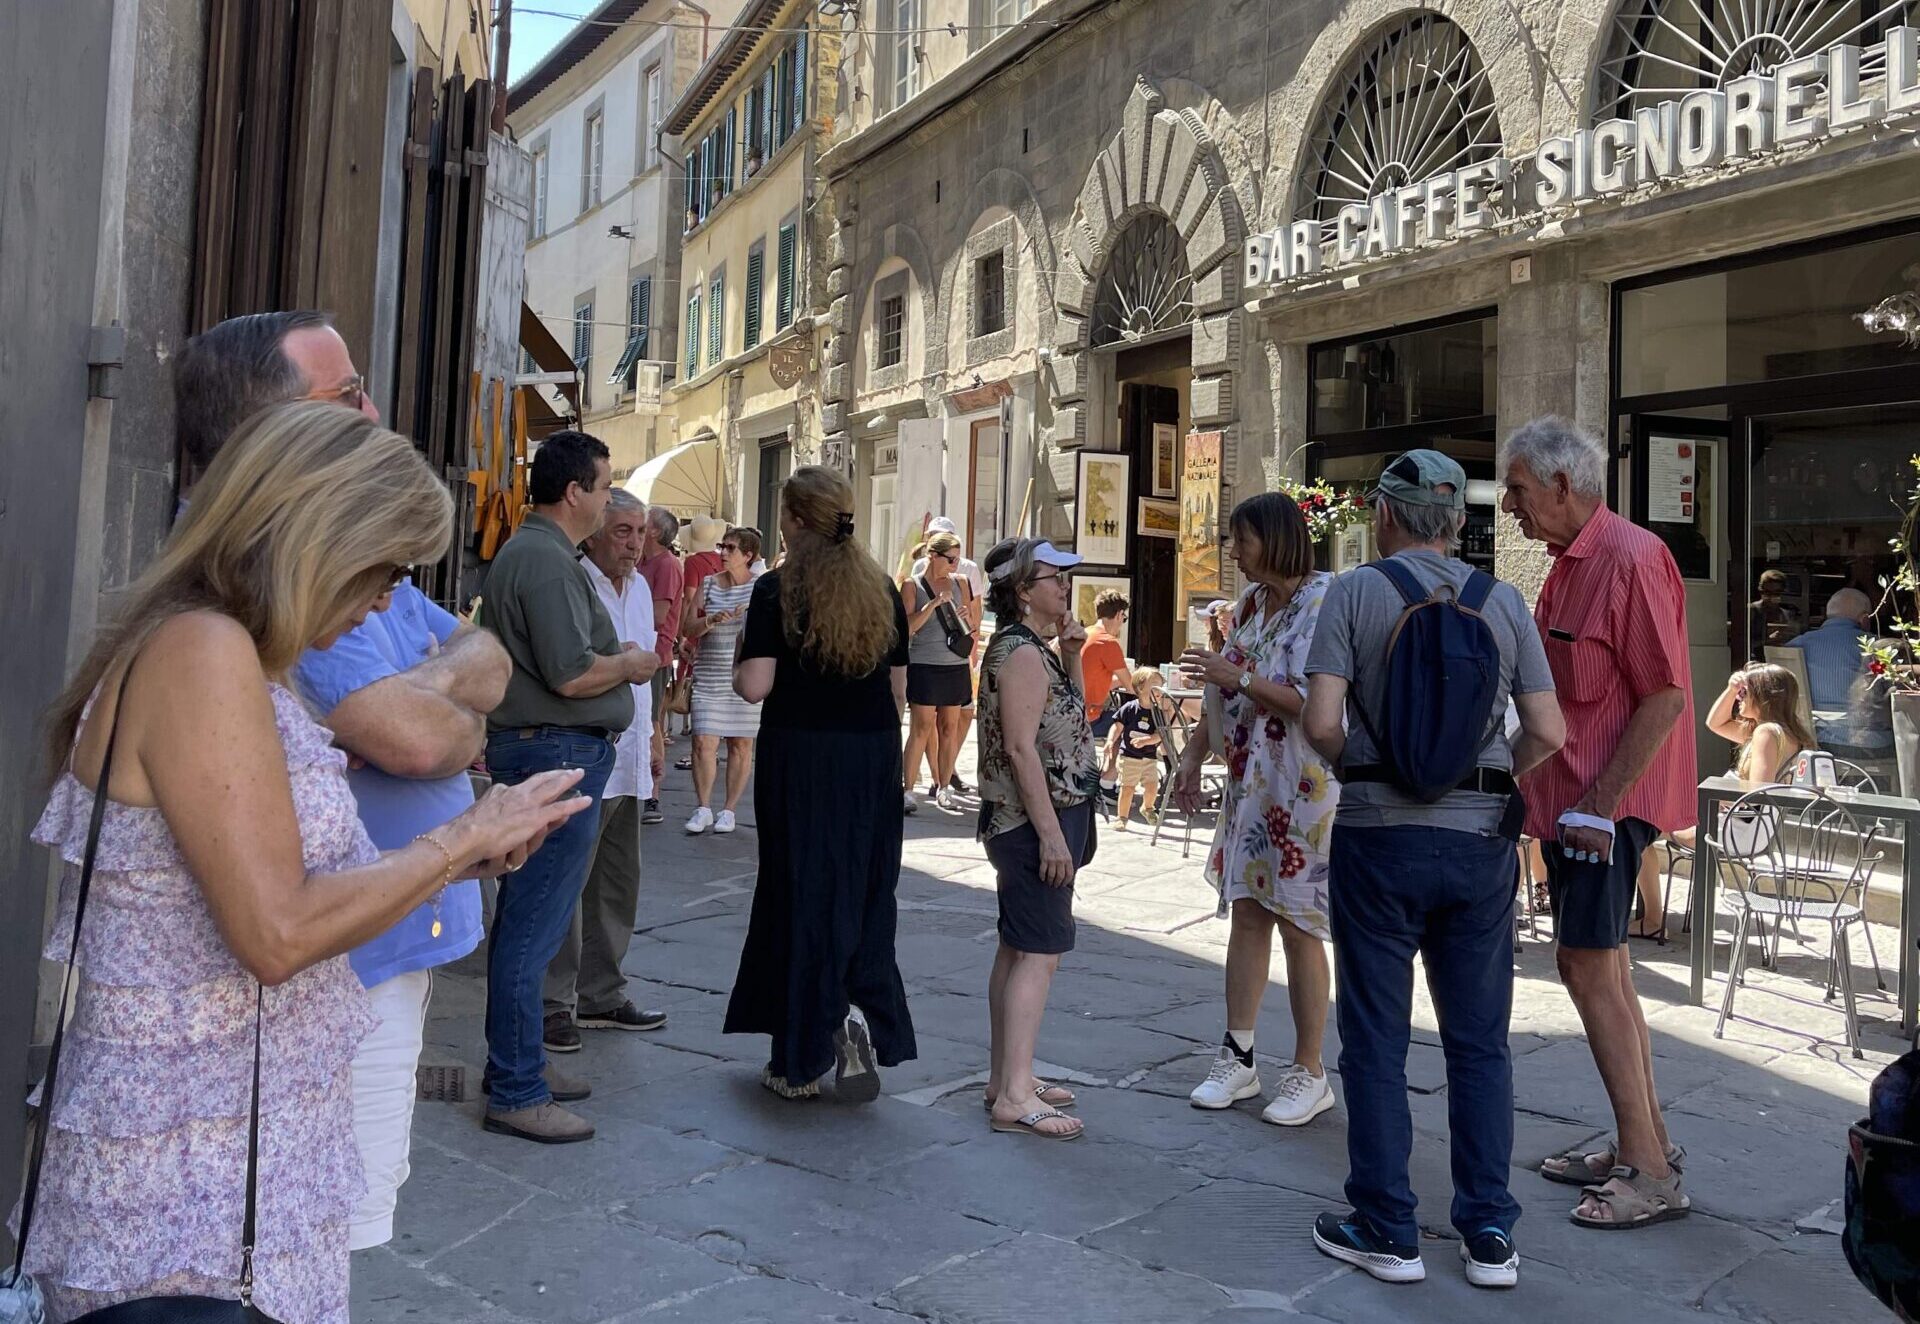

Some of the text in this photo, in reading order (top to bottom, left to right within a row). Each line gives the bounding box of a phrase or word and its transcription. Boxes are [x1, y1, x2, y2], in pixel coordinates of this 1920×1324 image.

[1244, 219, 1321, 288] BAR
[1517, 263, 1525, 278] 2
[783, 354, 794, 363] IL
[772, 363, 804, 382] POZZO
[1187, 456, 1217, 468] GALLERIA
[1187, 470, 1217, 480] NAZIONALE
